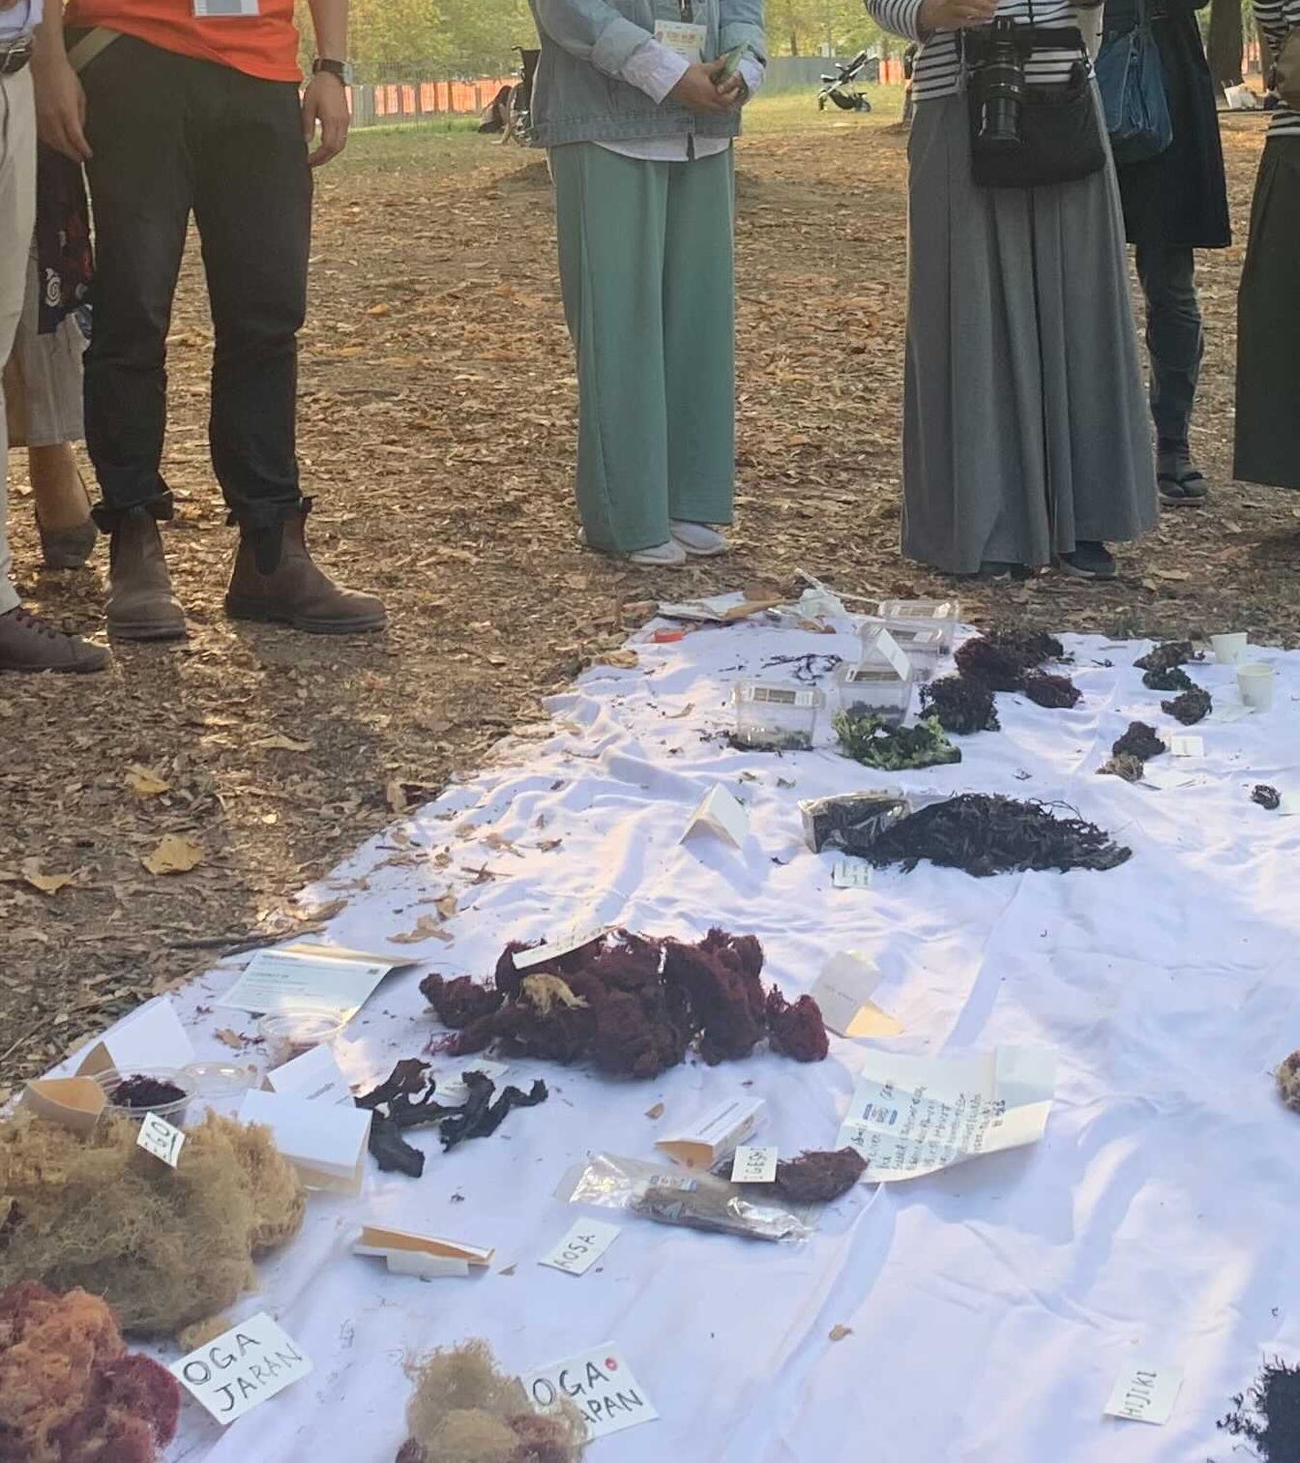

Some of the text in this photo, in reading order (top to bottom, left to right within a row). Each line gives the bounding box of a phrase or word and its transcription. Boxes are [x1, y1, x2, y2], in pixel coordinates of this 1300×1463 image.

[182, 1331, 260, 1387] OGA
[530, 1359, 610, 1407] OGA
[580, 1387, 645, 1429] APAN
